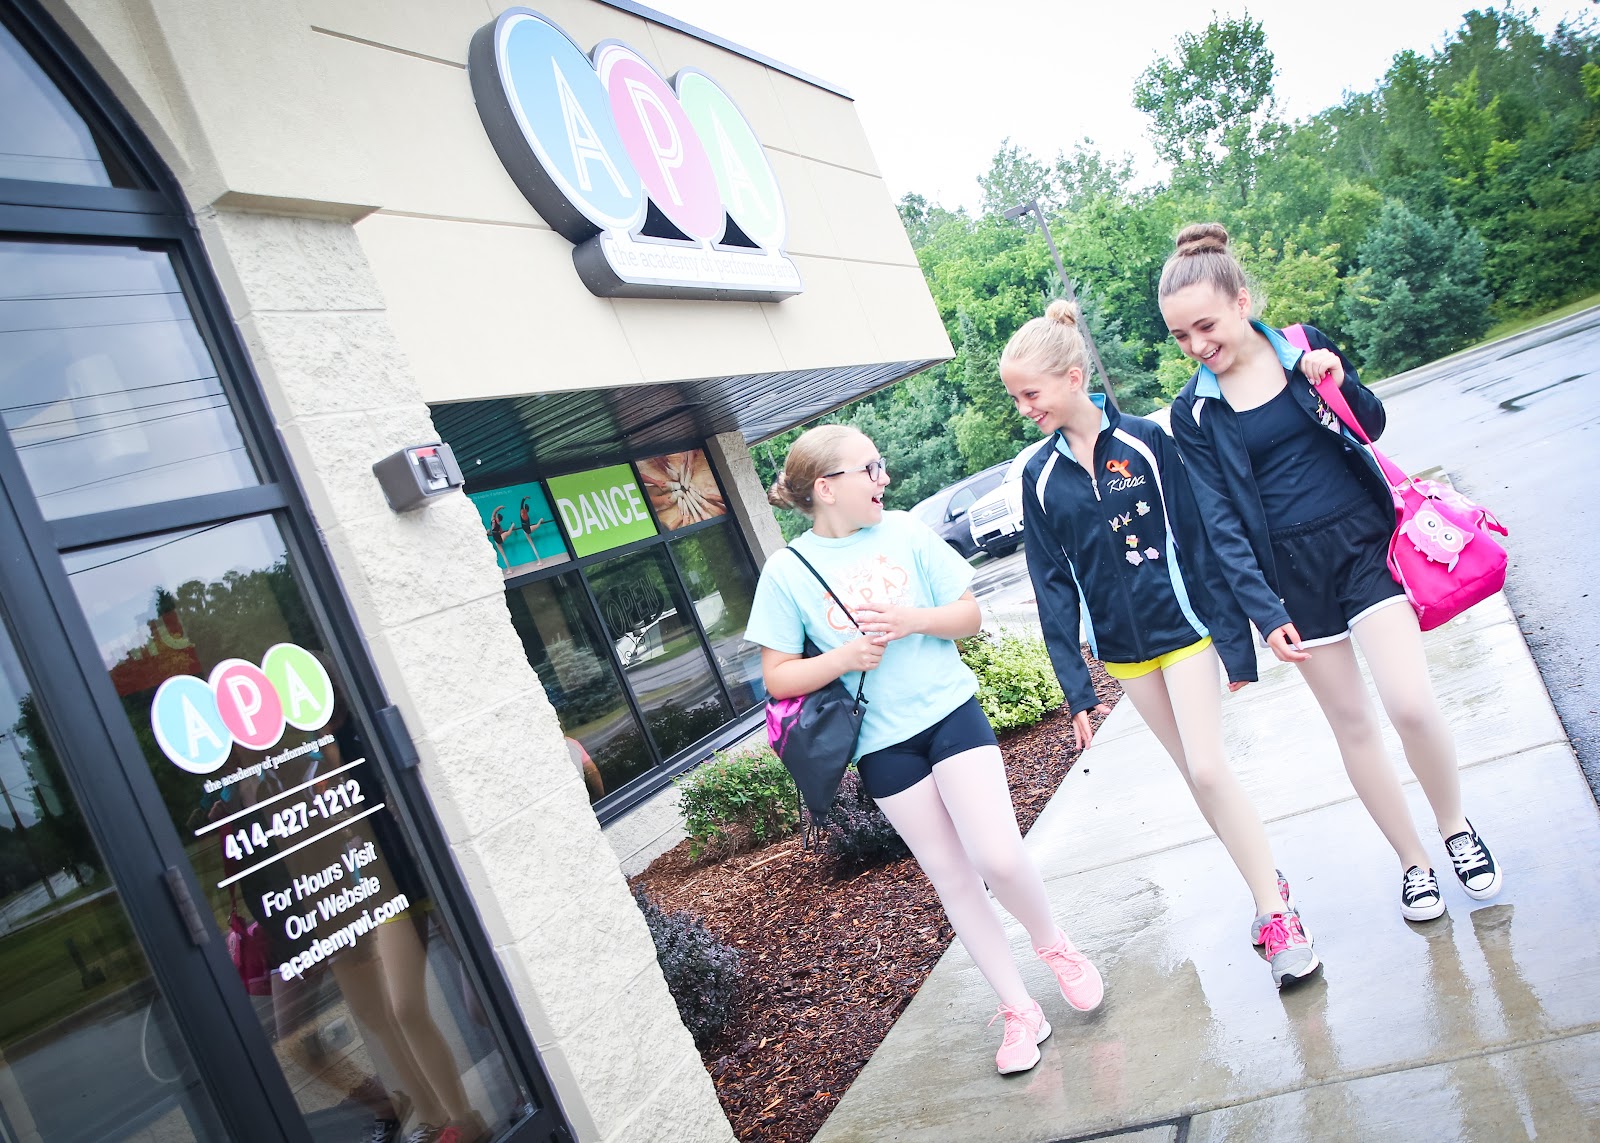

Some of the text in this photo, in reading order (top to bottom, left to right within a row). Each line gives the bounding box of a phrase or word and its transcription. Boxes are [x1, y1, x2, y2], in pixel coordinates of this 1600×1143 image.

[551, 55, 771, 222] APA
[612, 241, 796, 280] the academy of performing arts
[557, 483, 648, 538] DANCE
[1107, 475, 1146, 493] Kirsa
[606, 574, 660, 637] OPEN
[182, 658, 322, 758] APA
[204, 734, 335, 793] the academy of performing arts
[224, 779, 366, 861] 414-427-1212
[261, 841, 378, 918] For Hours Visit
[285, 876, 381, 940] Our Website
[279, 893, 410, 982] academywi.com
